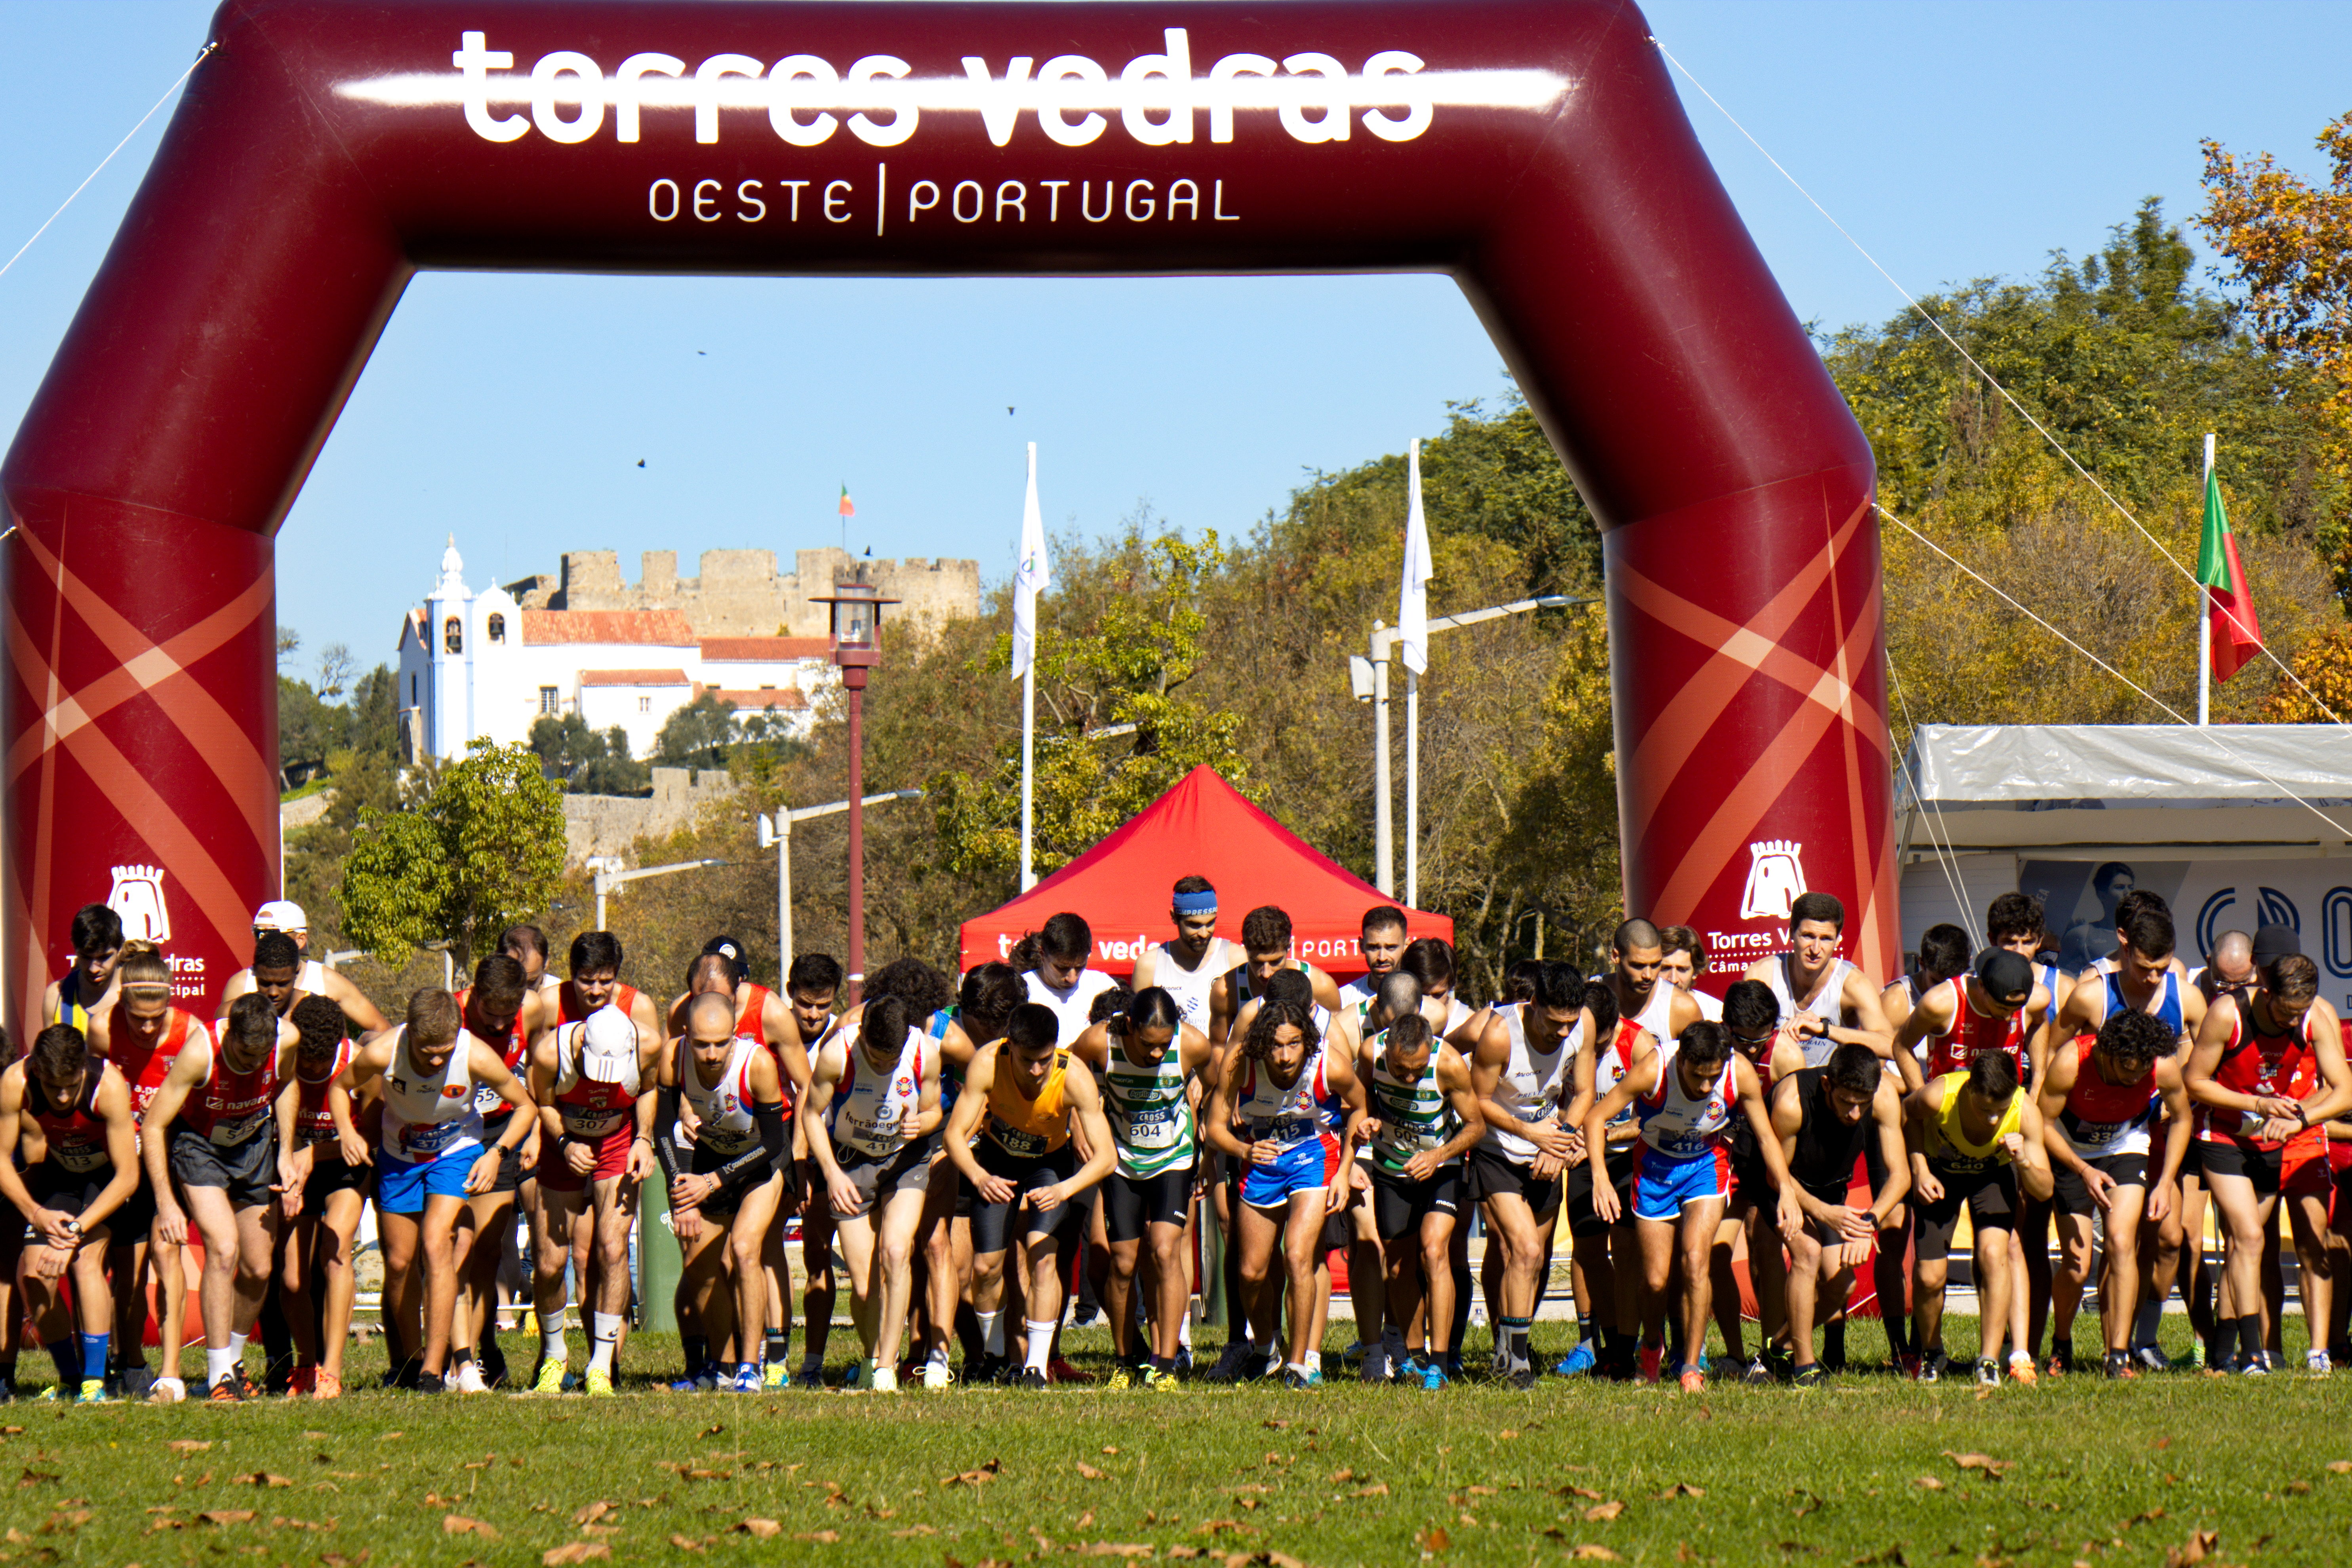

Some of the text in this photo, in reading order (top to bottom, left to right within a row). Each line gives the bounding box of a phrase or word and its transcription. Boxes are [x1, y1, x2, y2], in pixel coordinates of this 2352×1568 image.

[453, 27, 1434, 147] torres vedras
[648, 178, 1241, 223] OESTE PORTUGAL
[1708, 931, 1772, 950] Torres
[1302, 939, 1359, 957] PORT
[164, 953, 205, 972] dras
[1709, 961, 1752, 973] Câma
[169, 984, 205, 998] cipal
[476, 1089, 501, 1102] 55
[299, 1111, 331, 1121] nava
[1139, 1111, 1165, 1121] CROSS
[575, 1119, 608, 1128] 307
[1130, 1124, 1161, 1137] 604
[1269, 1123, 1301, 1142] 415
[1394, 1128, 1420, 1145] 601
[1001, 1132, 1031, 1151] 188
[2088, 1131, 2114, 1144] 33
[1672, 1141, 1705, 1151] 416
[59, 1155, 91, 1165] 113
